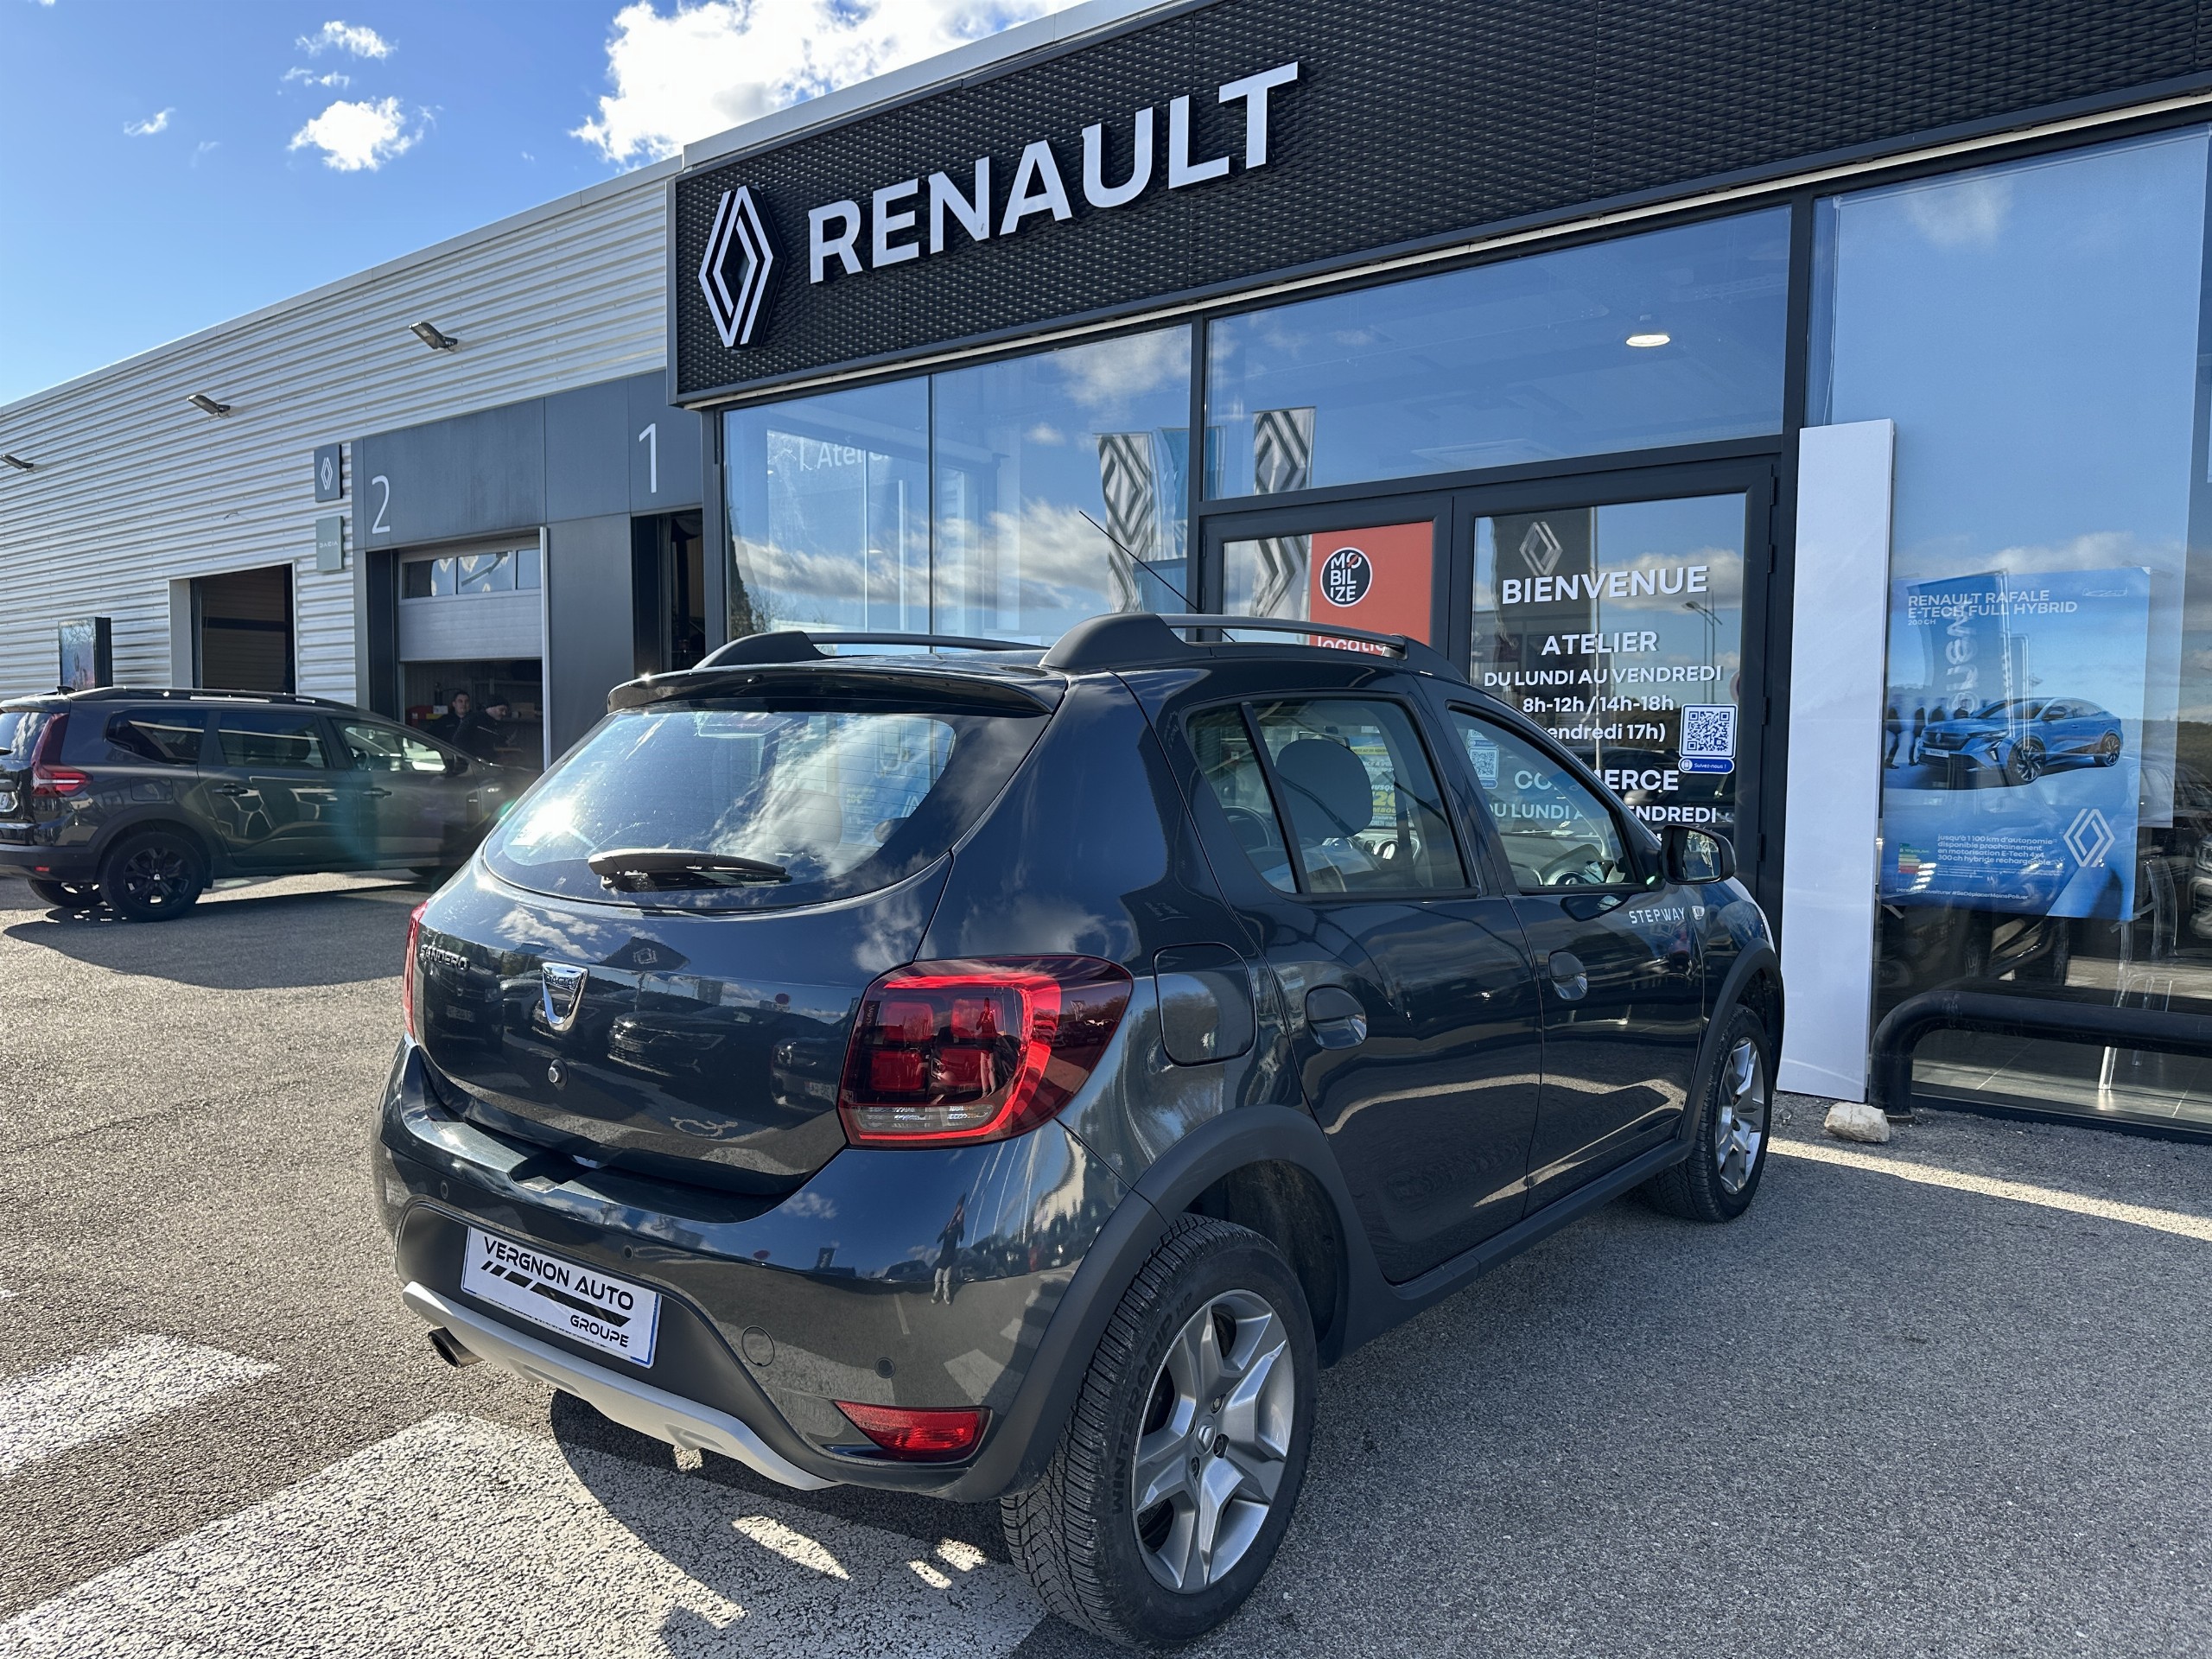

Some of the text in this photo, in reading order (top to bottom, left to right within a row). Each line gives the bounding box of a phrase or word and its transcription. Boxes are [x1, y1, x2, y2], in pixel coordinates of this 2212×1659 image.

[808, 61, 1299, 285] RENAULT
[639, 423, 657, 493] 1
[372, 475, 390, 534] 2
[1331, 553, 1362, 569] MO
[1331, 569, 1357, 585] BIL
[1502, 565, 1707, 605] BIENVENUE
[1331, 586, 1357, 601] IZE
[1908, 589, 2050, 607] RENAULT RAFALE
[1907, 601, 2078, 619] E-TECH FULL HYBRID
[1541, 631, 1658, 655] ATELIER
[1484, 665, 1722, 687] DU LUNDI AU VENDREDI
[1522, 696, 1585, 713] 8h-12h
[1601, 695, 1674, 712] 14h-18h
[1626, 723, 1666, 741] 17h)
[1511, 803, 1569, 819] LUNDI
[1937, 842, 2042, 853] disponible prochainement
[1629, 907, 1685, 924] STEPWAY
[419, 944, 470, 971] SANDERO
[484, 1236, 634, 1319] VERGNON AUTO
[570, 1314, 630, 1348] GROUPE
[1112, 1313, 1173, 1516] WINTERGRIP
